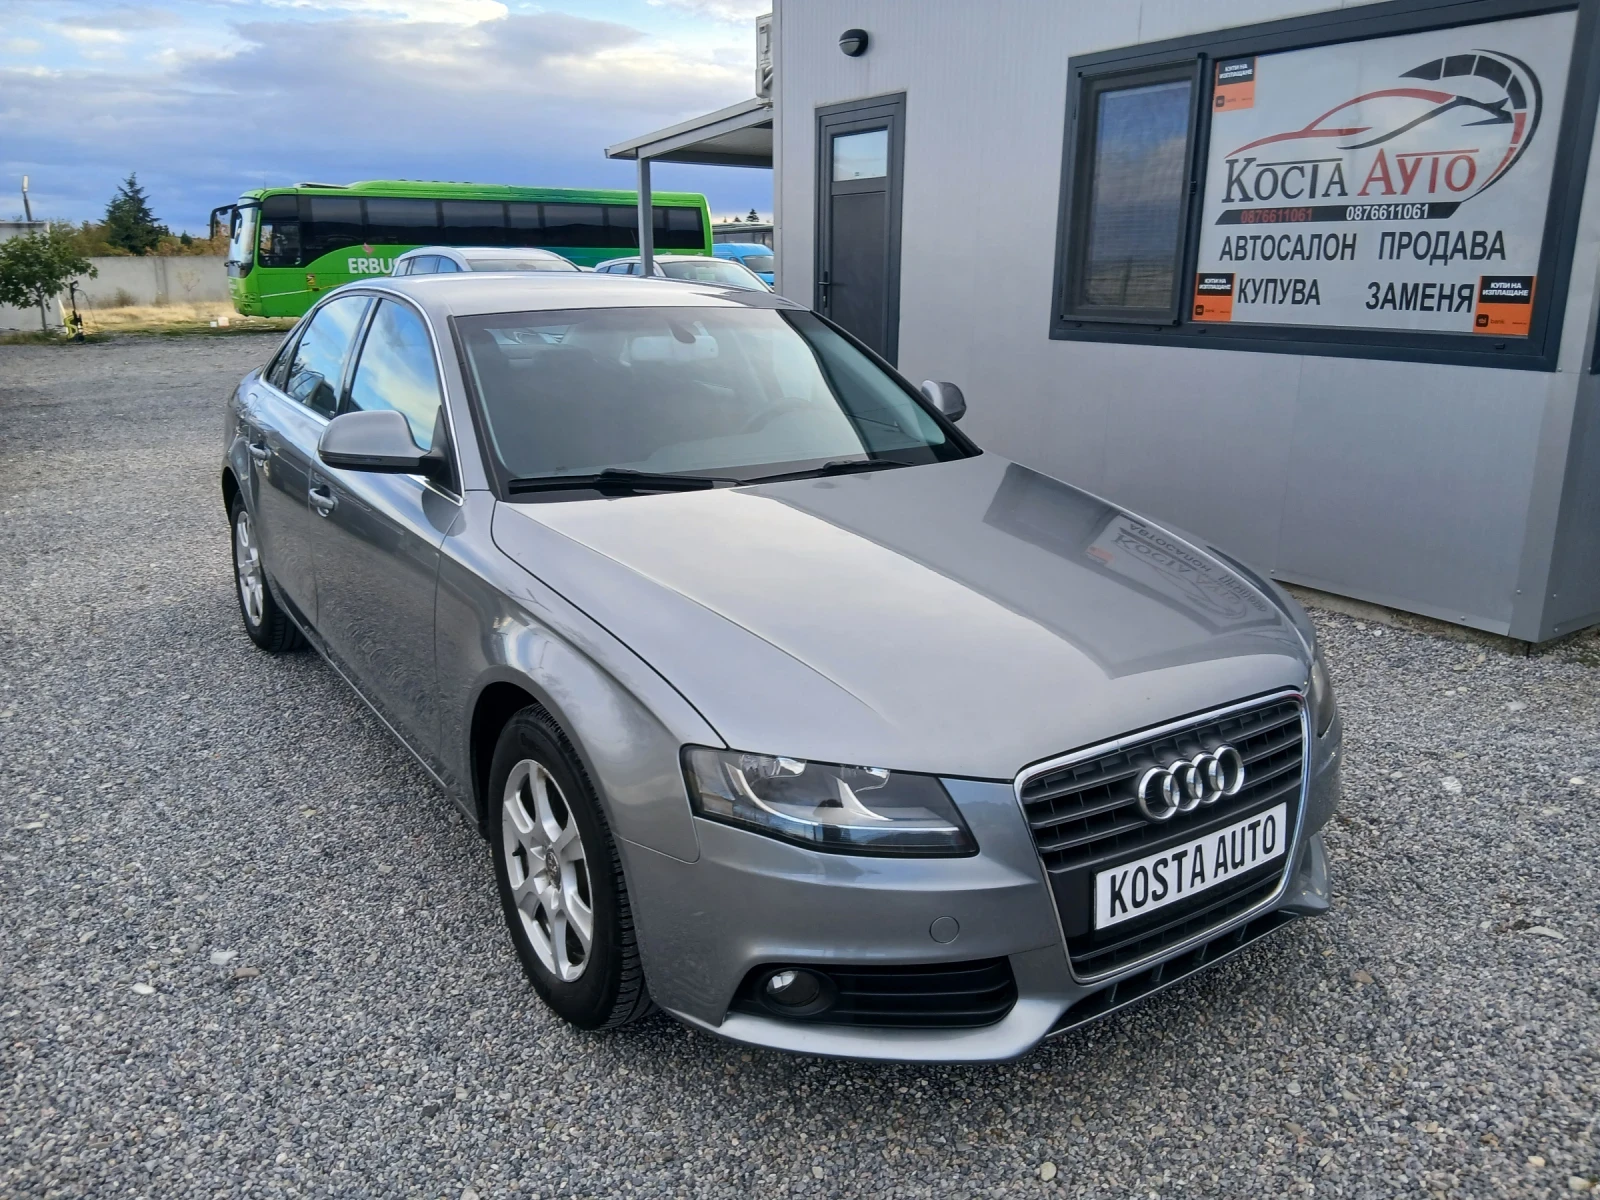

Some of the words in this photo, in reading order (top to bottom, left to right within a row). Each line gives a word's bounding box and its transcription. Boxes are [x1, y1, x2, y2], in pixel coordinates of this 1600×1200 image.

[1240, 207, 1313, 224] 0876611061
[1346, 203, 1429, 221] 0876611061
[1219, 233, 1357, 262] АВТОСАЛОН
[1378, 230, 1506, 266] ПРОДАВА
[1237, 278, 1321, 305] КУПУВА
[1365, 281, 1475, 314] ЗАМЕНЯ
[1109, 843, 1206, 918] KOSTA
[1213, 814, 1276, 879] AUTO
